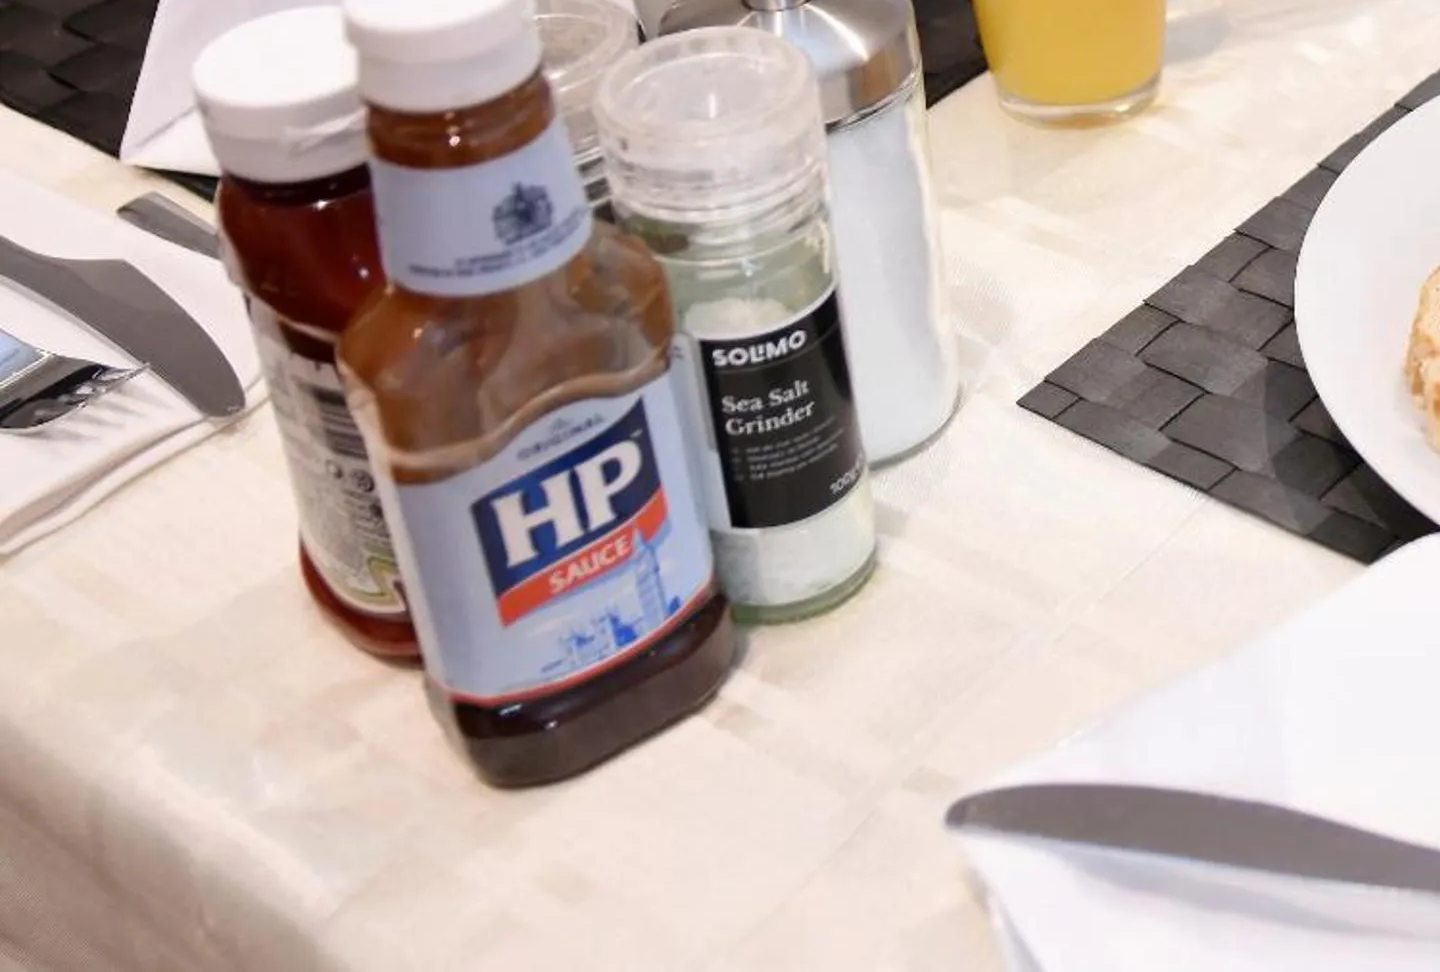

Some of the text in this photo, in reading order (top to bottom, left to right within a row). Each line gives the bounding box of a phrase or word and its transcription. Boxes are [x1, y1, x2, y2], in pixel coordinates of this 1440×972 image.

[721, 379, 810, 413] Sea Salt
[725, 400, 815, 436] Grinder
[491, 439, 644, 569] HP
[548, 535, 632, 595] SAUCE
